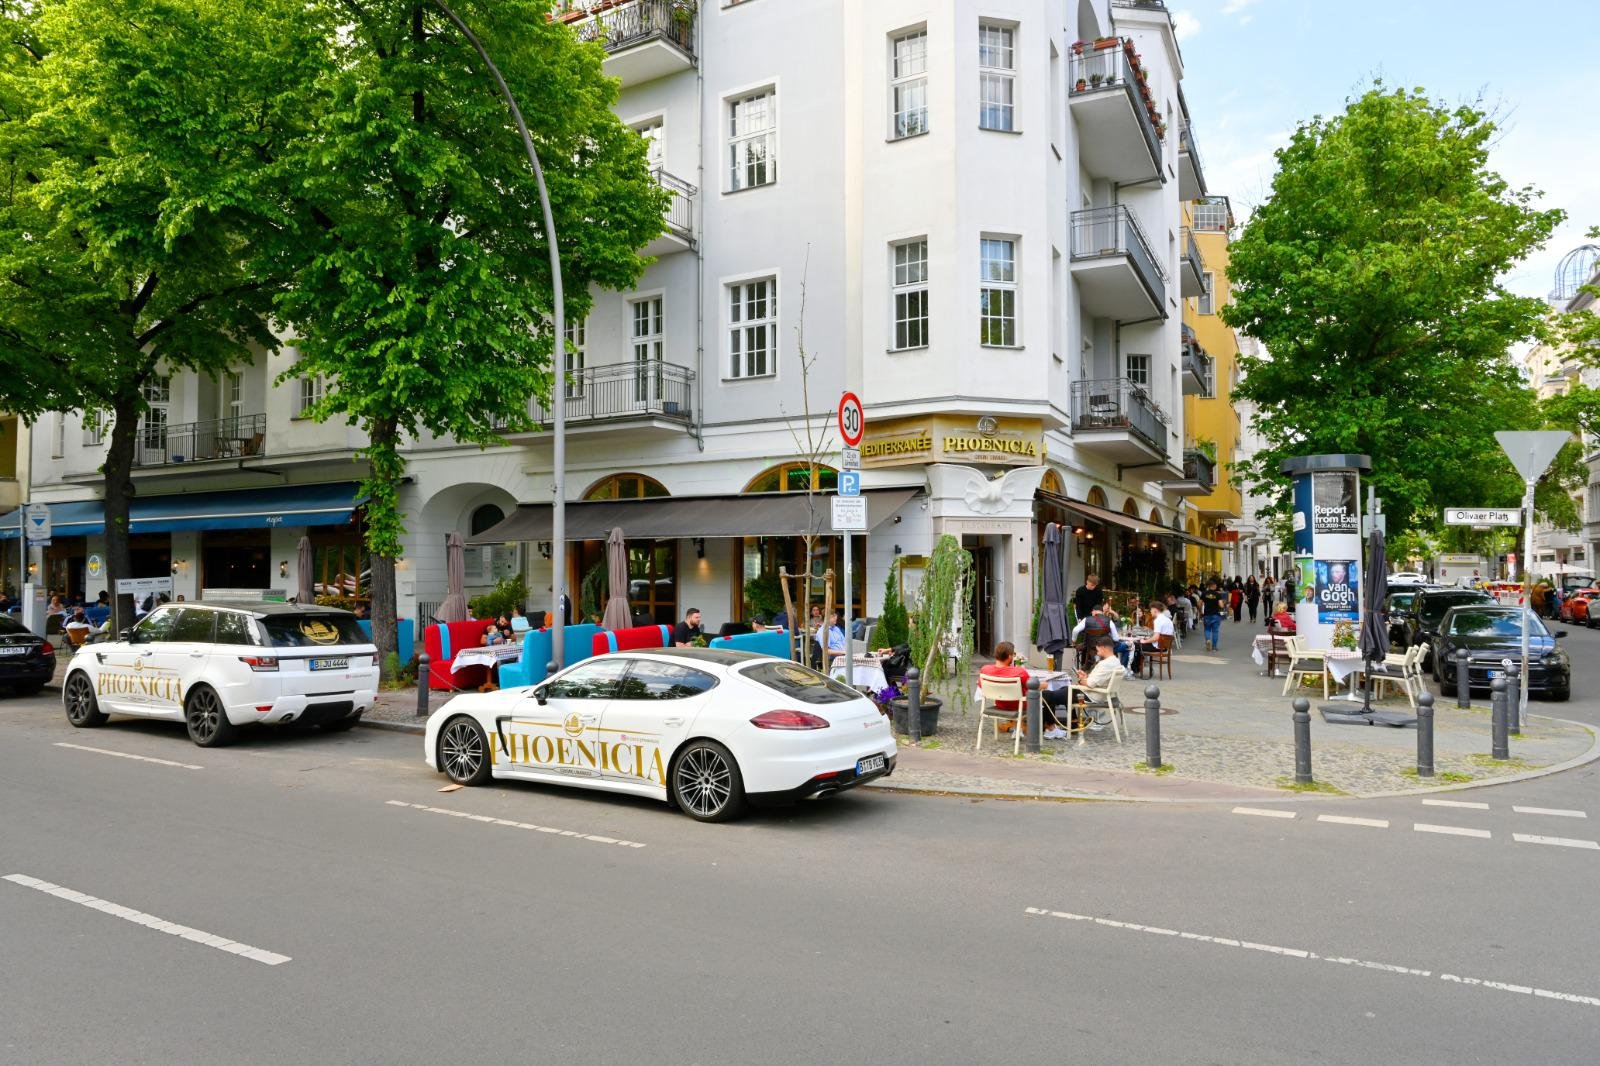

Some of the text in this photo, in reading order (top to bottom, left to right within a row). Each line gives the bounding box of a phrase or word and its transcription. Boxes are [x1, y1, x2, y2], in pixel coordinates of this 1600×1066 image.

[844, 406, 859, 433] 30
[943, 437, 1037, 456] PHOENICIA
[843, 475, 855, 493] P
[1314, 505, 1347, 516] Report
[1314, 513, 1339, 523] from
[1456, 511, 1509, 521] Olivaer Platz
[1320, 588, 1355, 606] Gogh
[1328, 583, 1348, 593] van
[97, 672, 185, 706] PHOENICIA
[489, 731, 667, 787] PHOENICIA
